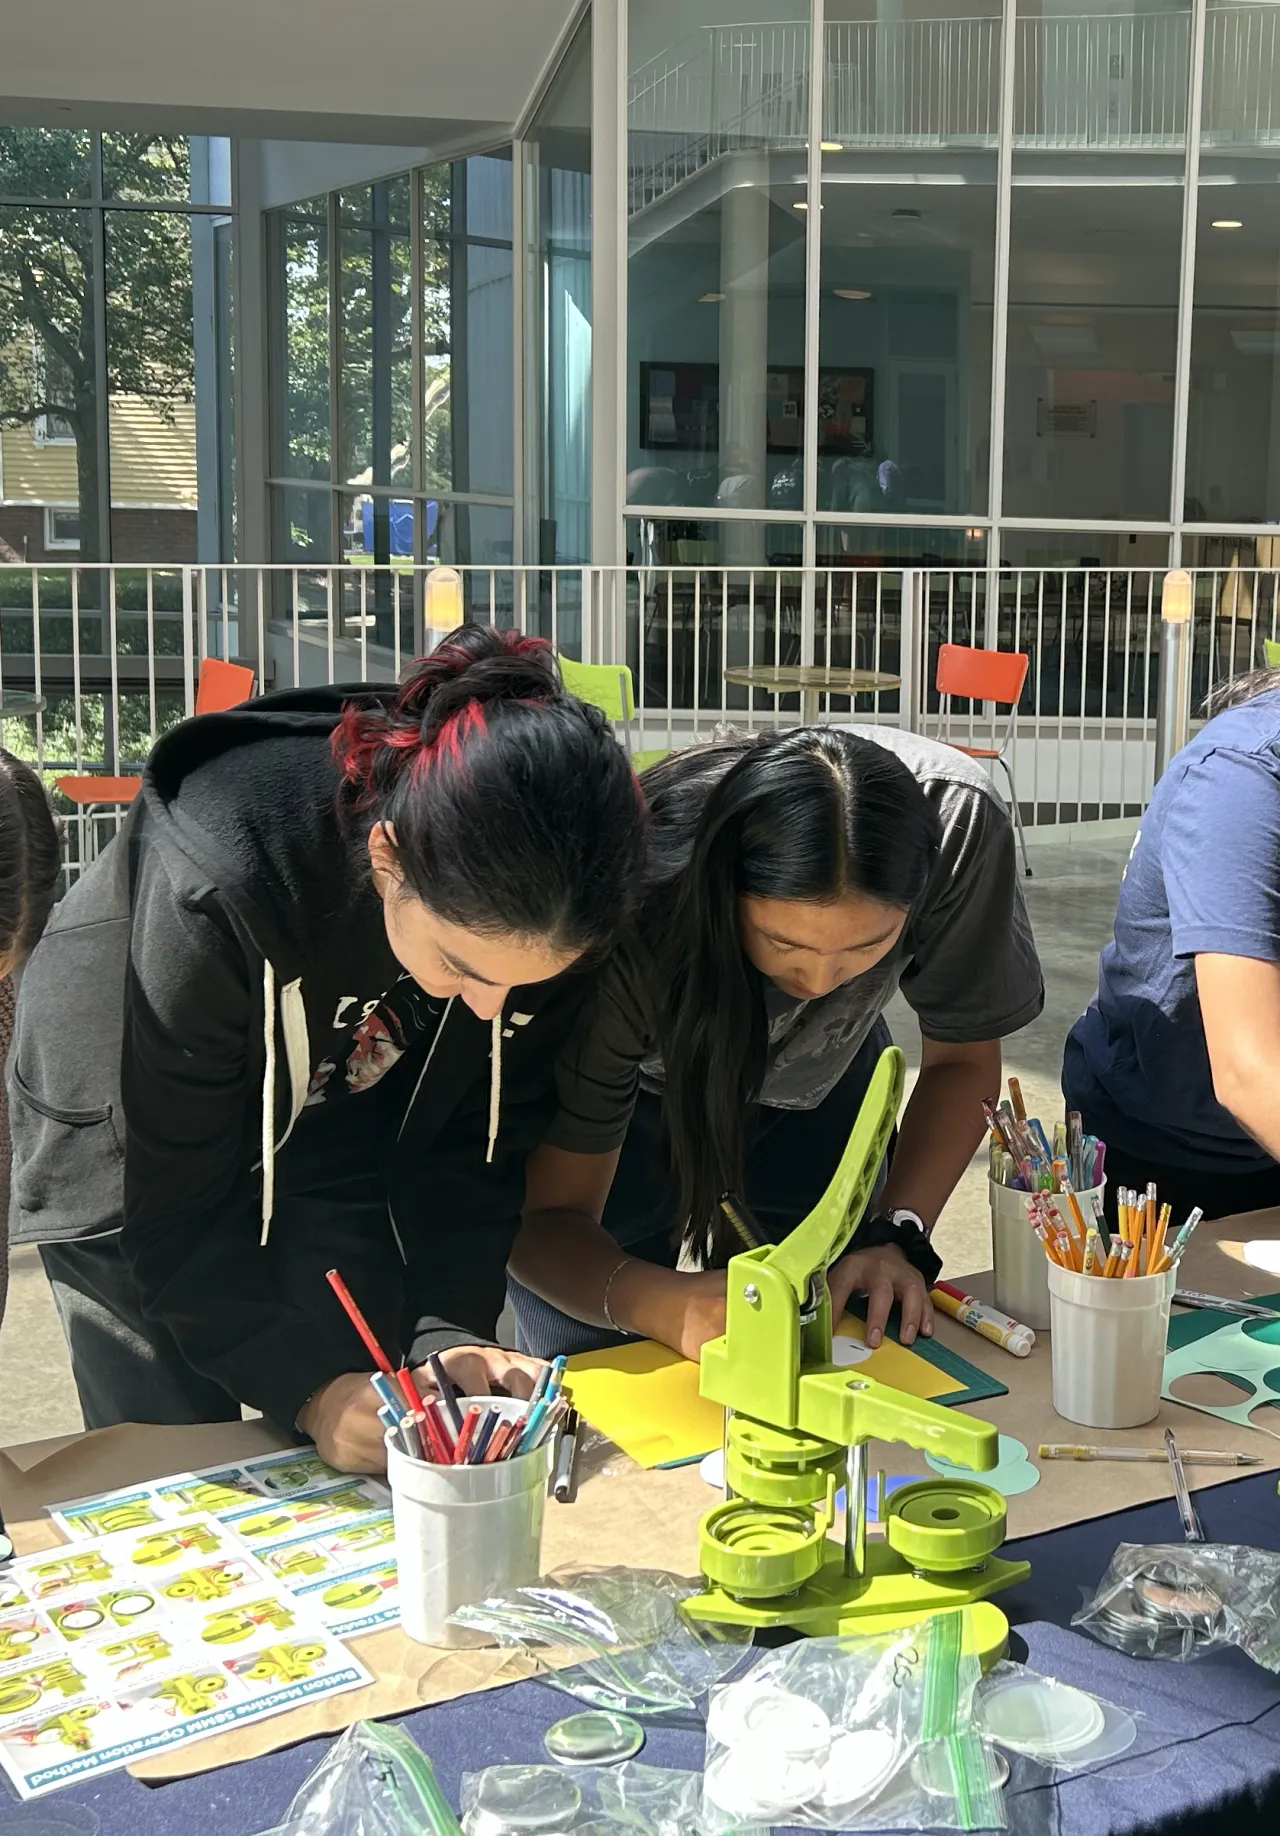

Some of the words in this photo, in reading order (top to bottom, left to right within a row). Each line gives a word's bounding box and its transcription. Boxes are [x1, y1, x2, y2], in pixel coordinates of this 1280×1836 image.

[304, 1669, 358, 1697] Button
[236, 1686, 302, 1715] Machine
[186, 1711, 236, 1735] 58MM
[101, 1726, 185, 1760] Operation
[30, 1754, 98, 1787] Method
